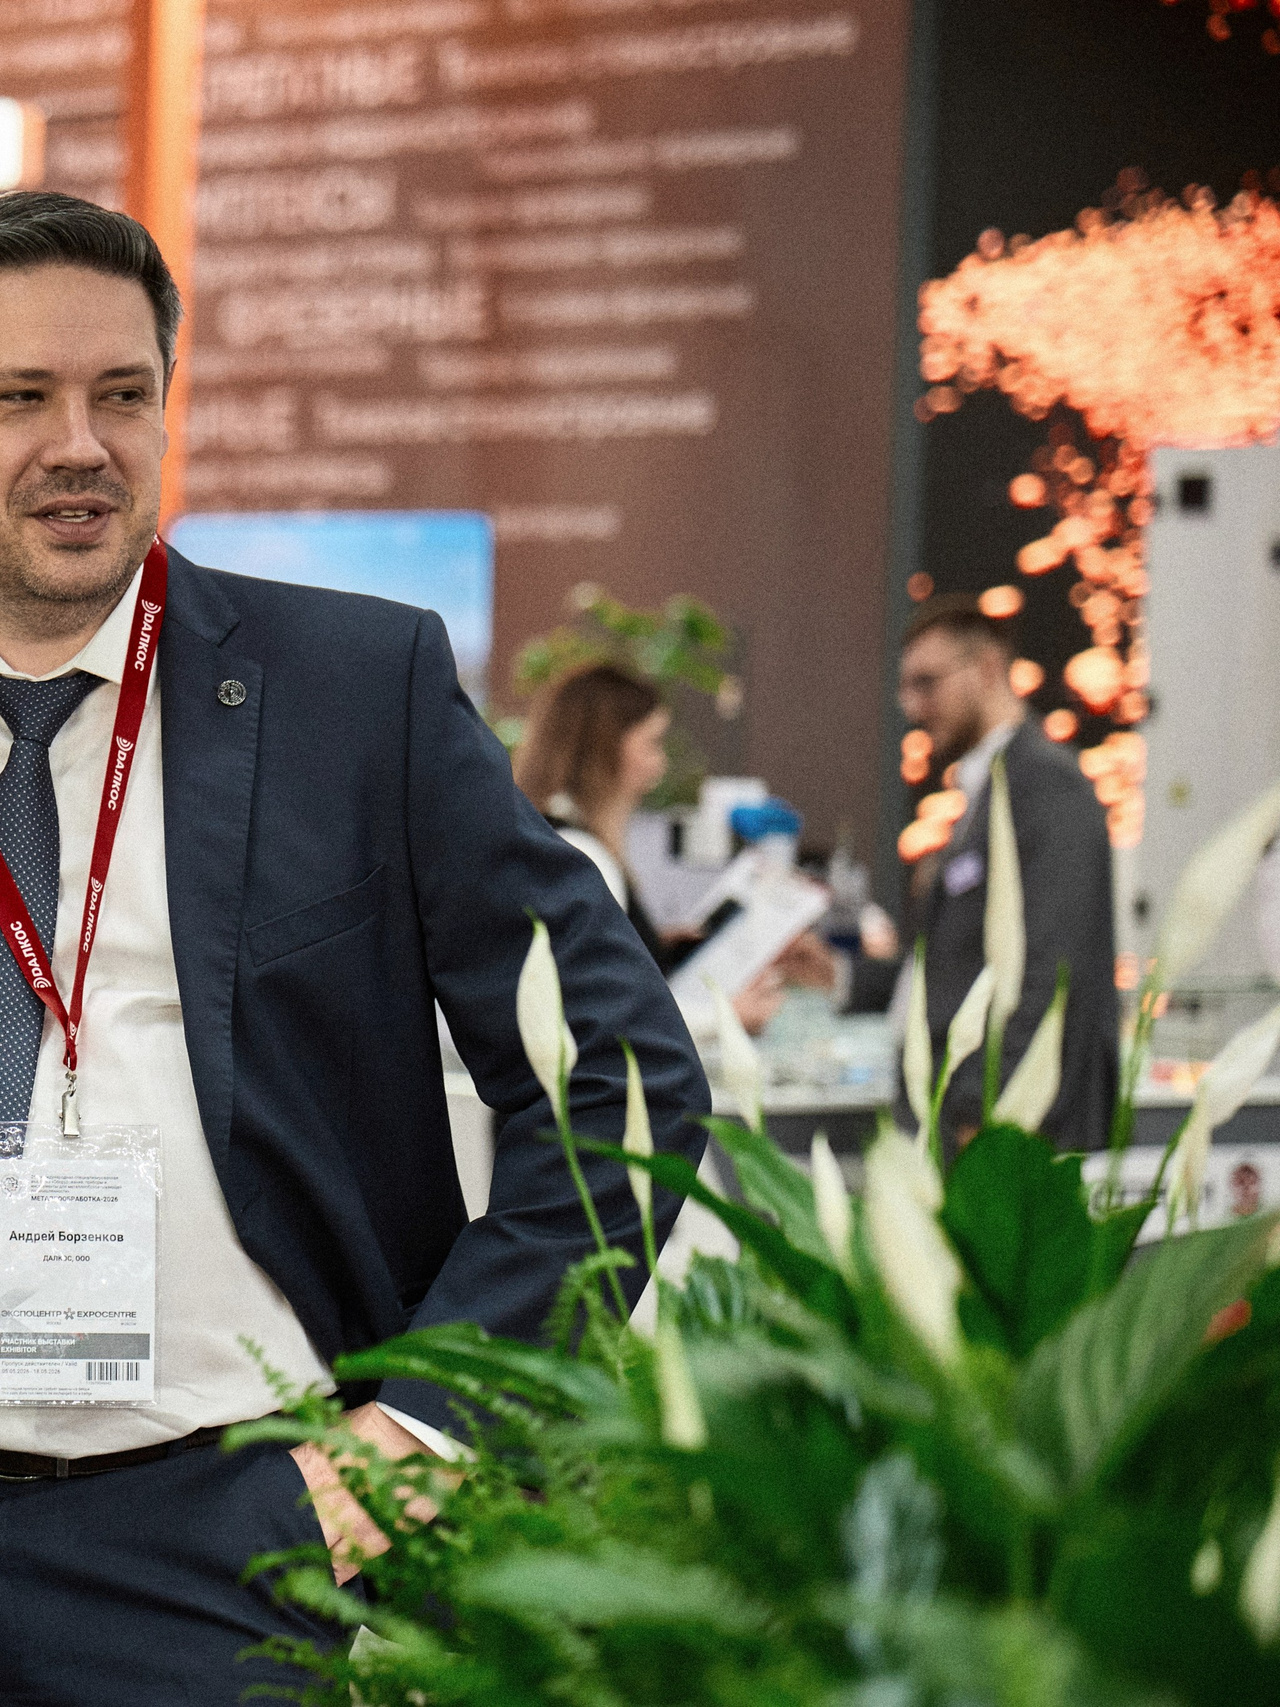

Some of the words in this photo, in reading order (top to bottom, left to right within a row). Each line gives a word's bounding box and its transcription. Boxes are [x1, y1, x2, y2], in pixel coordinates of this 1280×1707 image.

[30, 1195, 119, 1203] МЕТАООБРАБОТКА-2026
[9, 1230, 55, 1243] Андрей
[58, 1230, 124, 1244] Борзенков
[1, 1310, 62, 1319] ЭКСПОЦЕНТР
[76, 1310, 137, 1318] EXPOCENTRE
[0, 1338, 36, 1346] УЧАСТНИК
